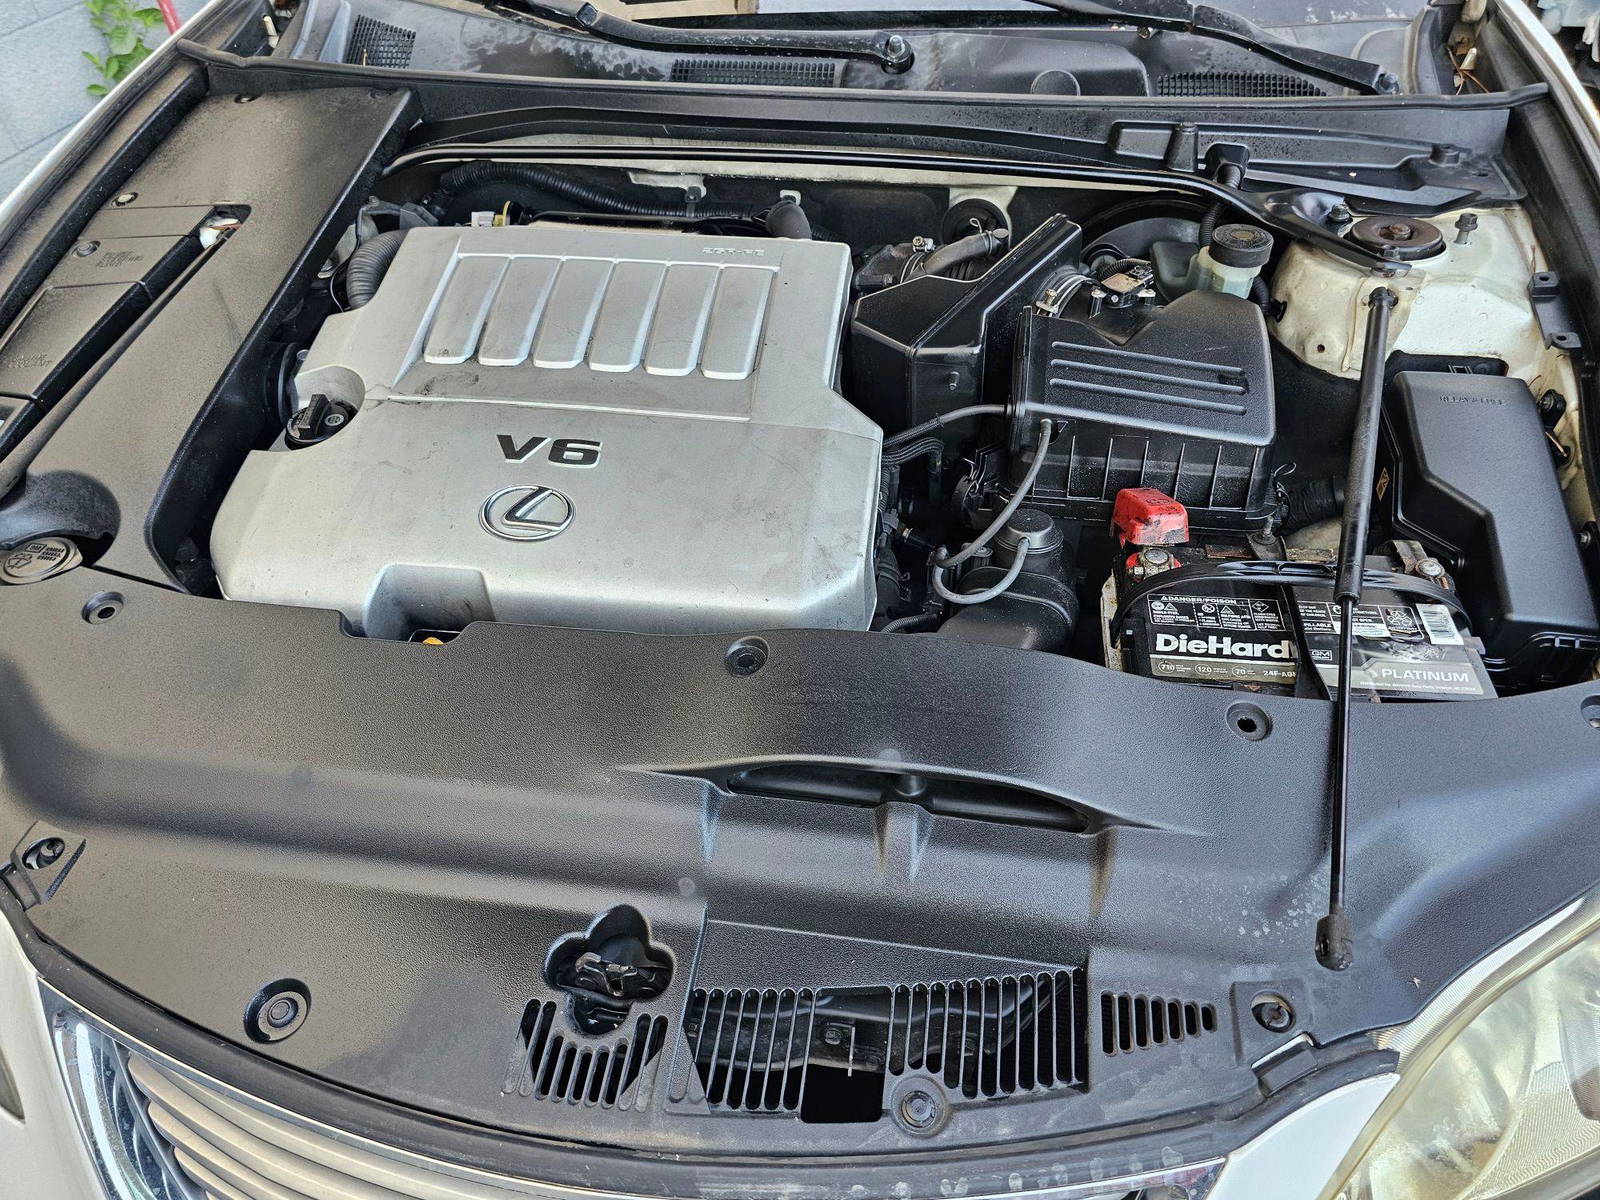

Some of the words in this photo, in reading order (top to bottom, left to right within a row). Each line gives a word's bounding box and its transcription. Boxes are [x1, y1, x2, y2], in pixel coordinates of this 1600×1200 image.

[496, 434, 603, 468] V6
[1155, 633, 1290, 659] DieHard
[1197, 665, 1213, 673] 120
[1381, 668, 1470, 682] PLATINUM
